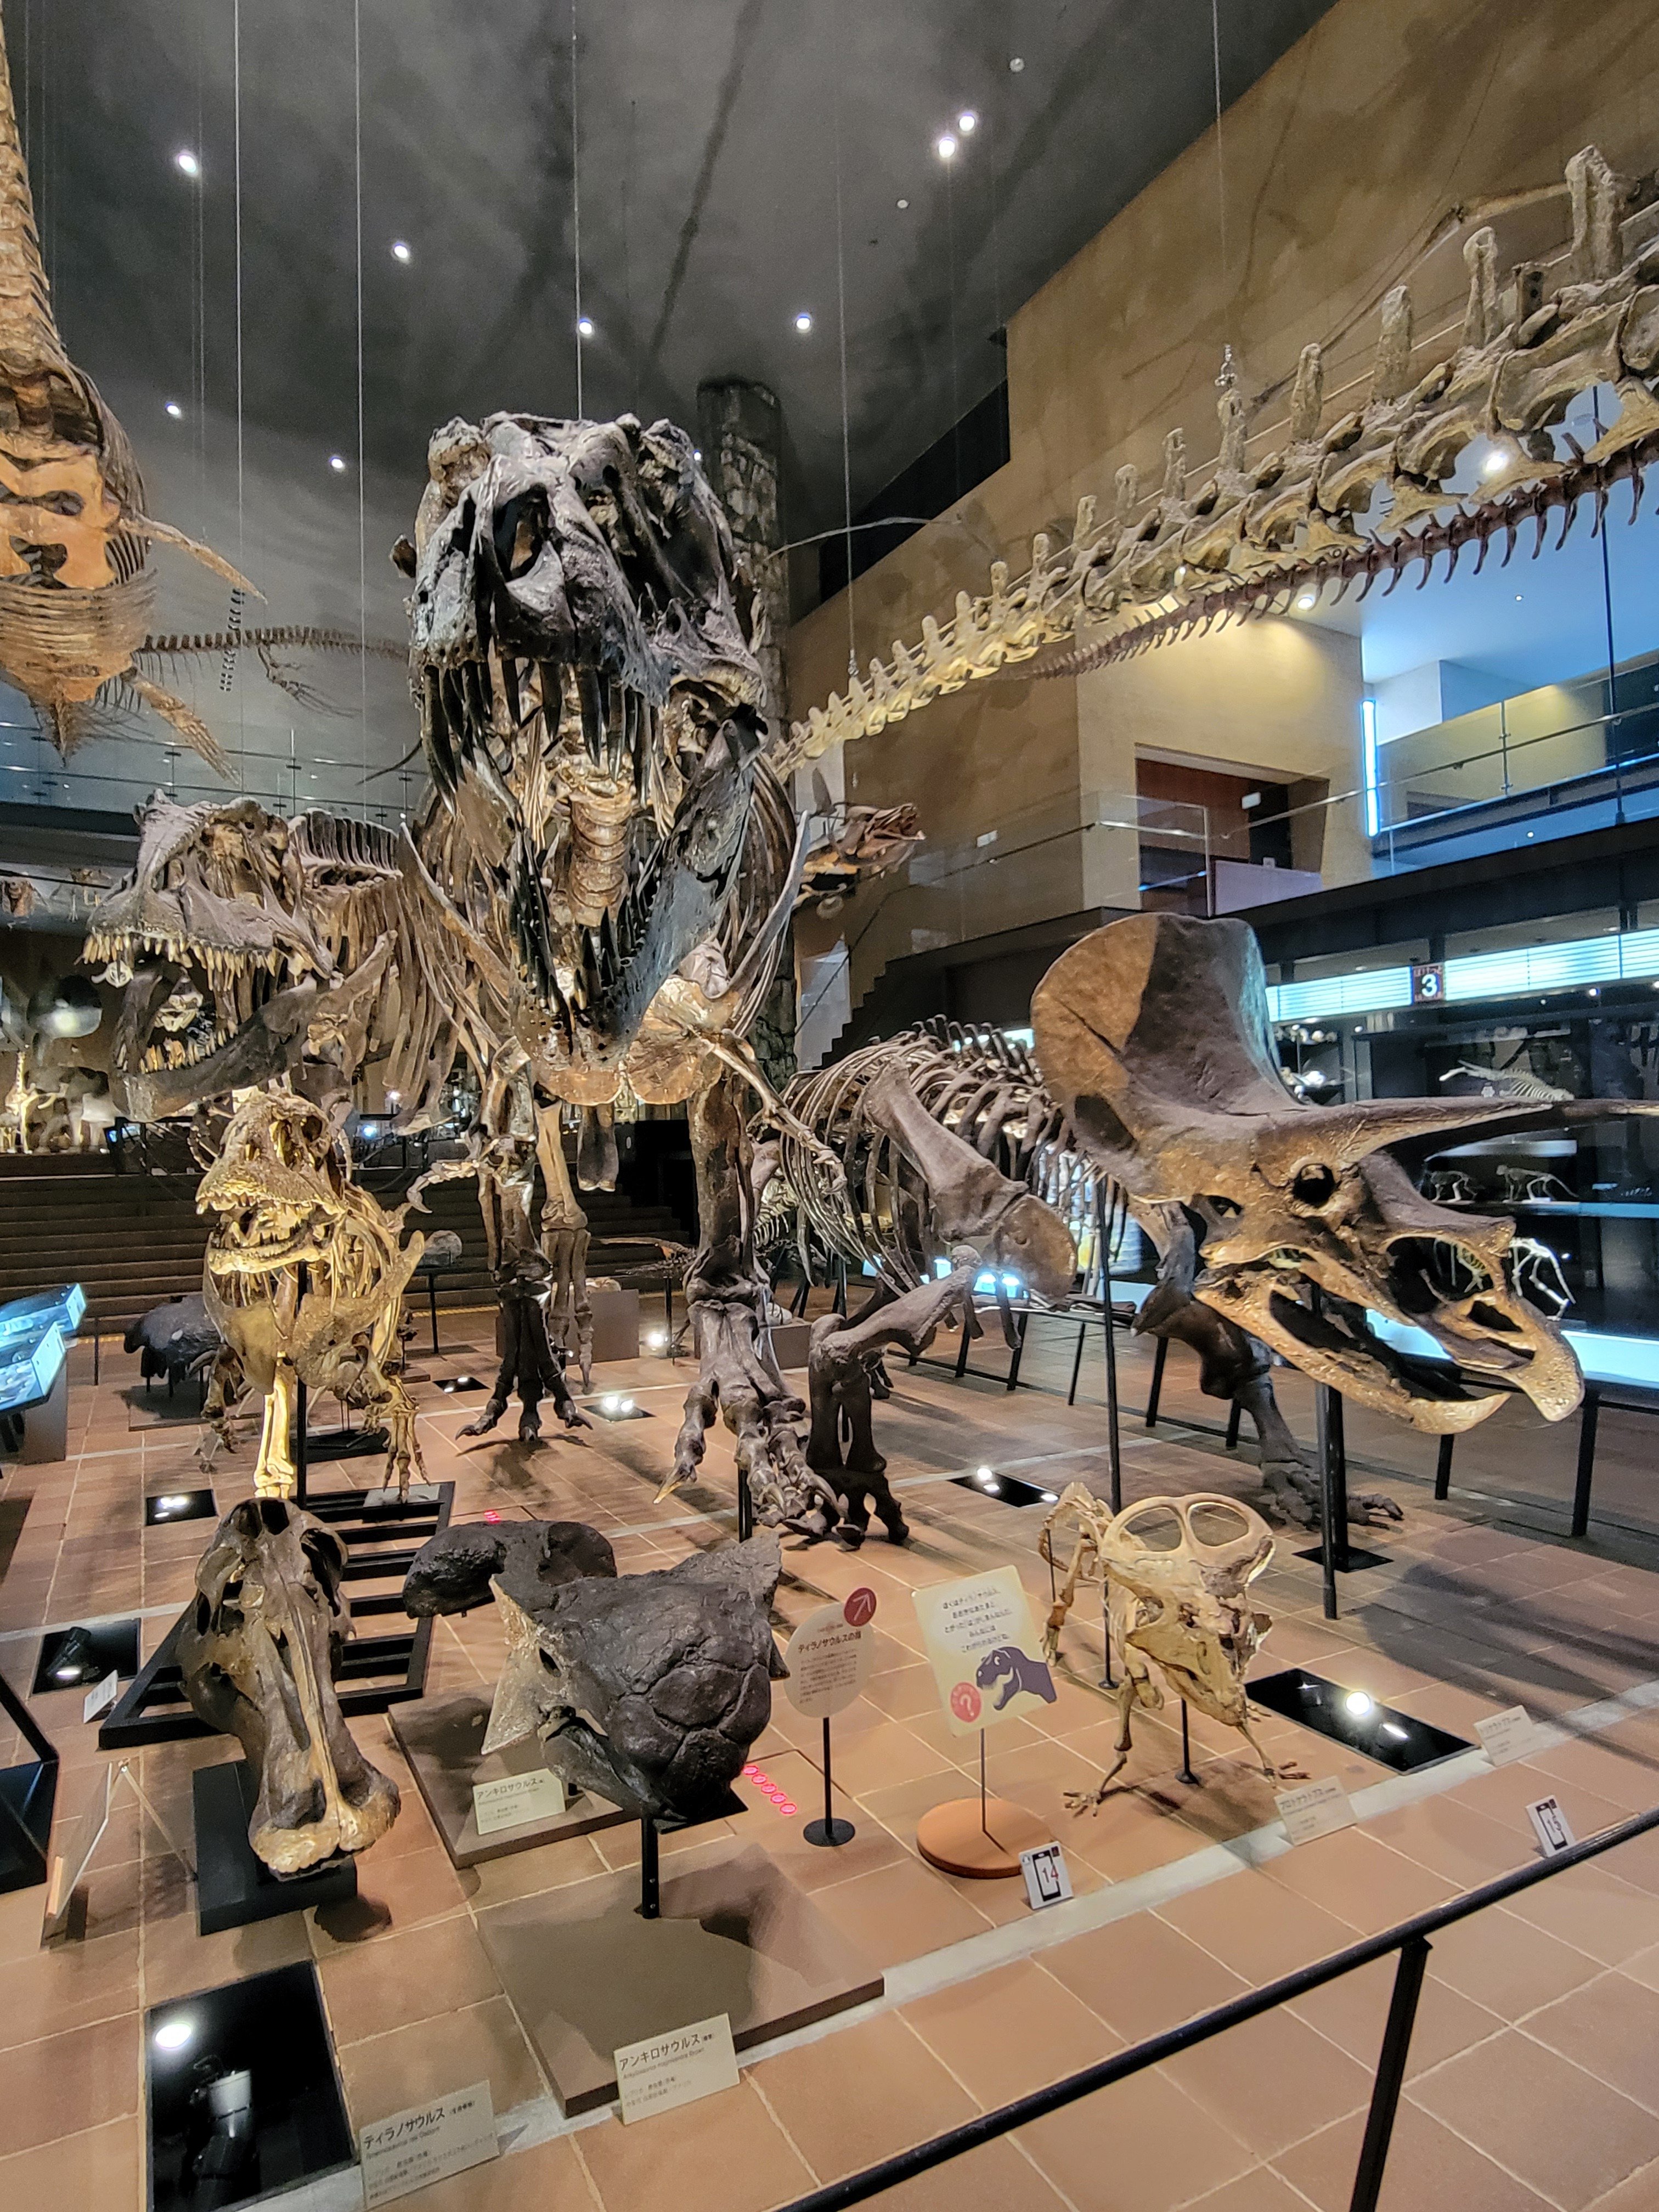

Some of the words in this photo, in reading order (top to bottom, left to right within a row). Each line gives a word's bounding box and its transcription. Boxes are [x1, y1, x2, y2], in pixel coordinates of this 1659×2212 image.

[1421, 974, 1437, 997] 3
[477, 1778, 537, 1799] アンキロサウルス
[1042, 1865, 1059, 1883] 14
[619, 2033, 700, 2071] アンキロサウルス
[364, 2107, 445, 2149] ティラノサウルス
